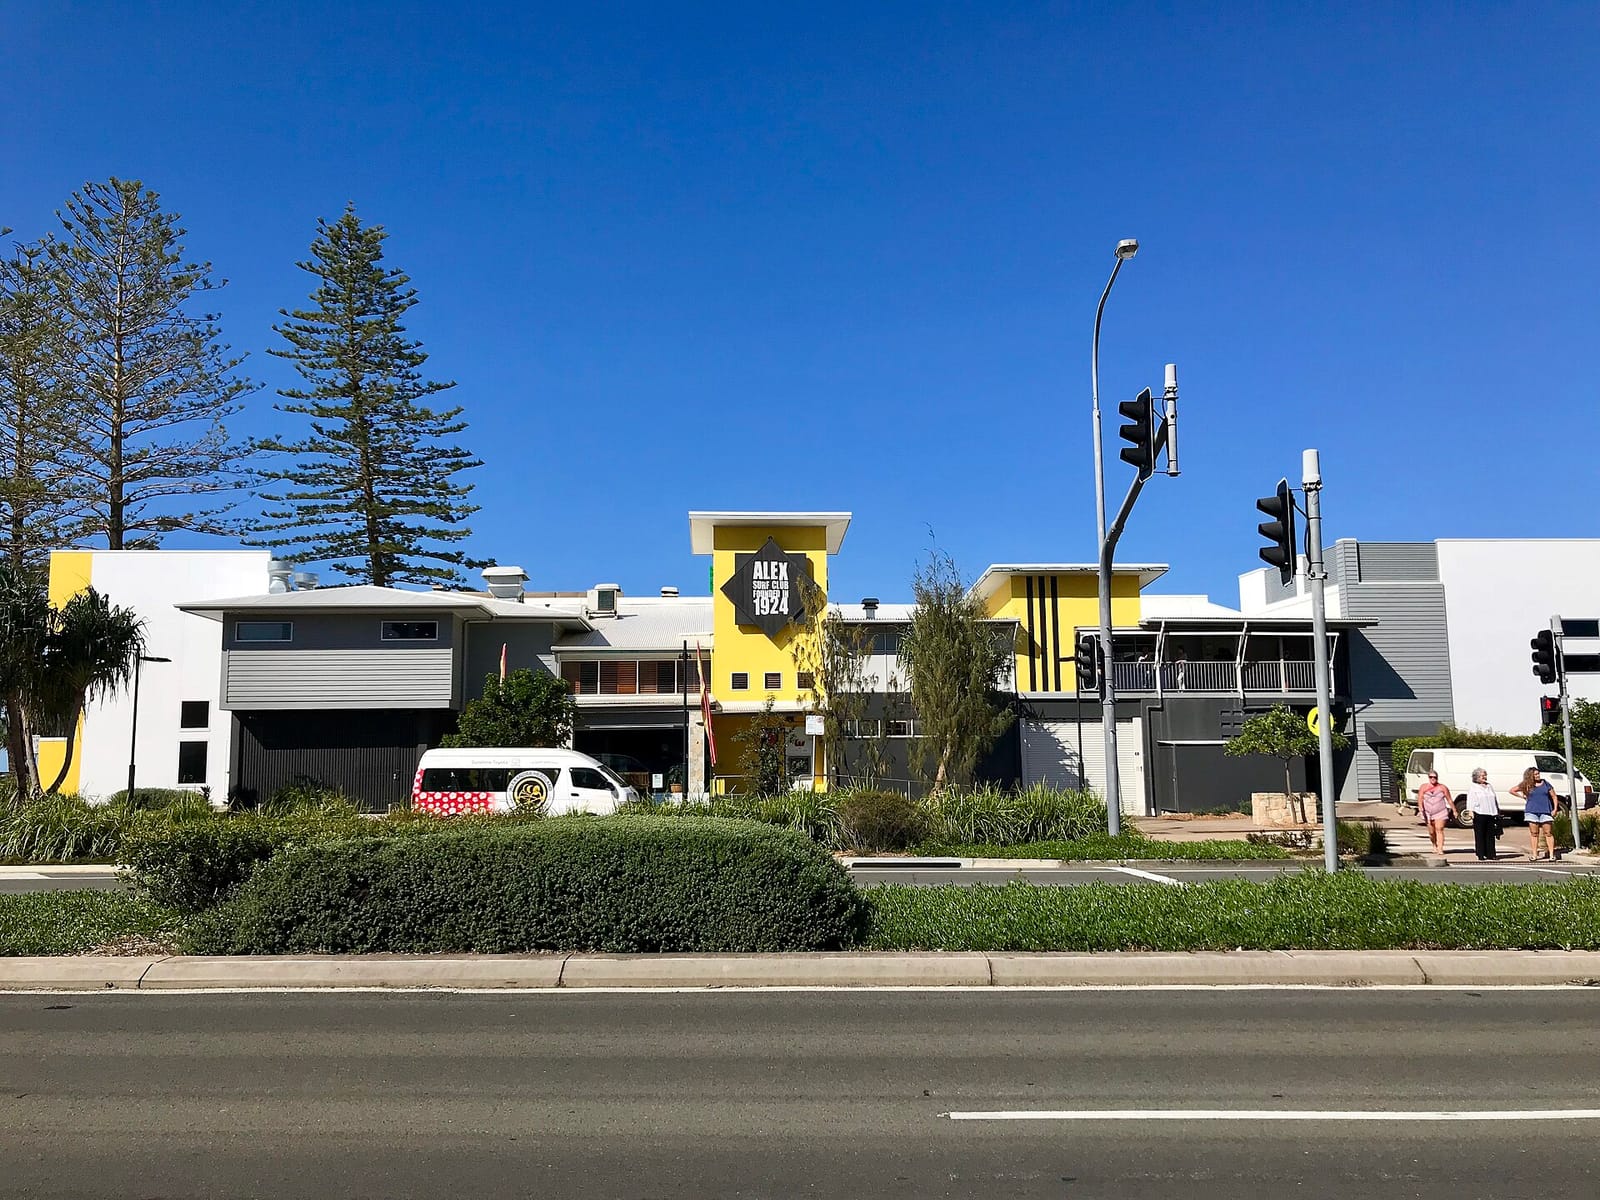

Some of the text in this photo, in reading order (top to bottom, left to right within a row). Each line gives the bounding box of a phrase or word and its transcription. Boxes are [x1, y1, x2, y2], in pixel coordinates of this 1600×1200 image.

[753, 561, 789, 580] ALEX
[752, 580, 789, 590] SURF CLUB
[753, 596, 789, 615] 1924
